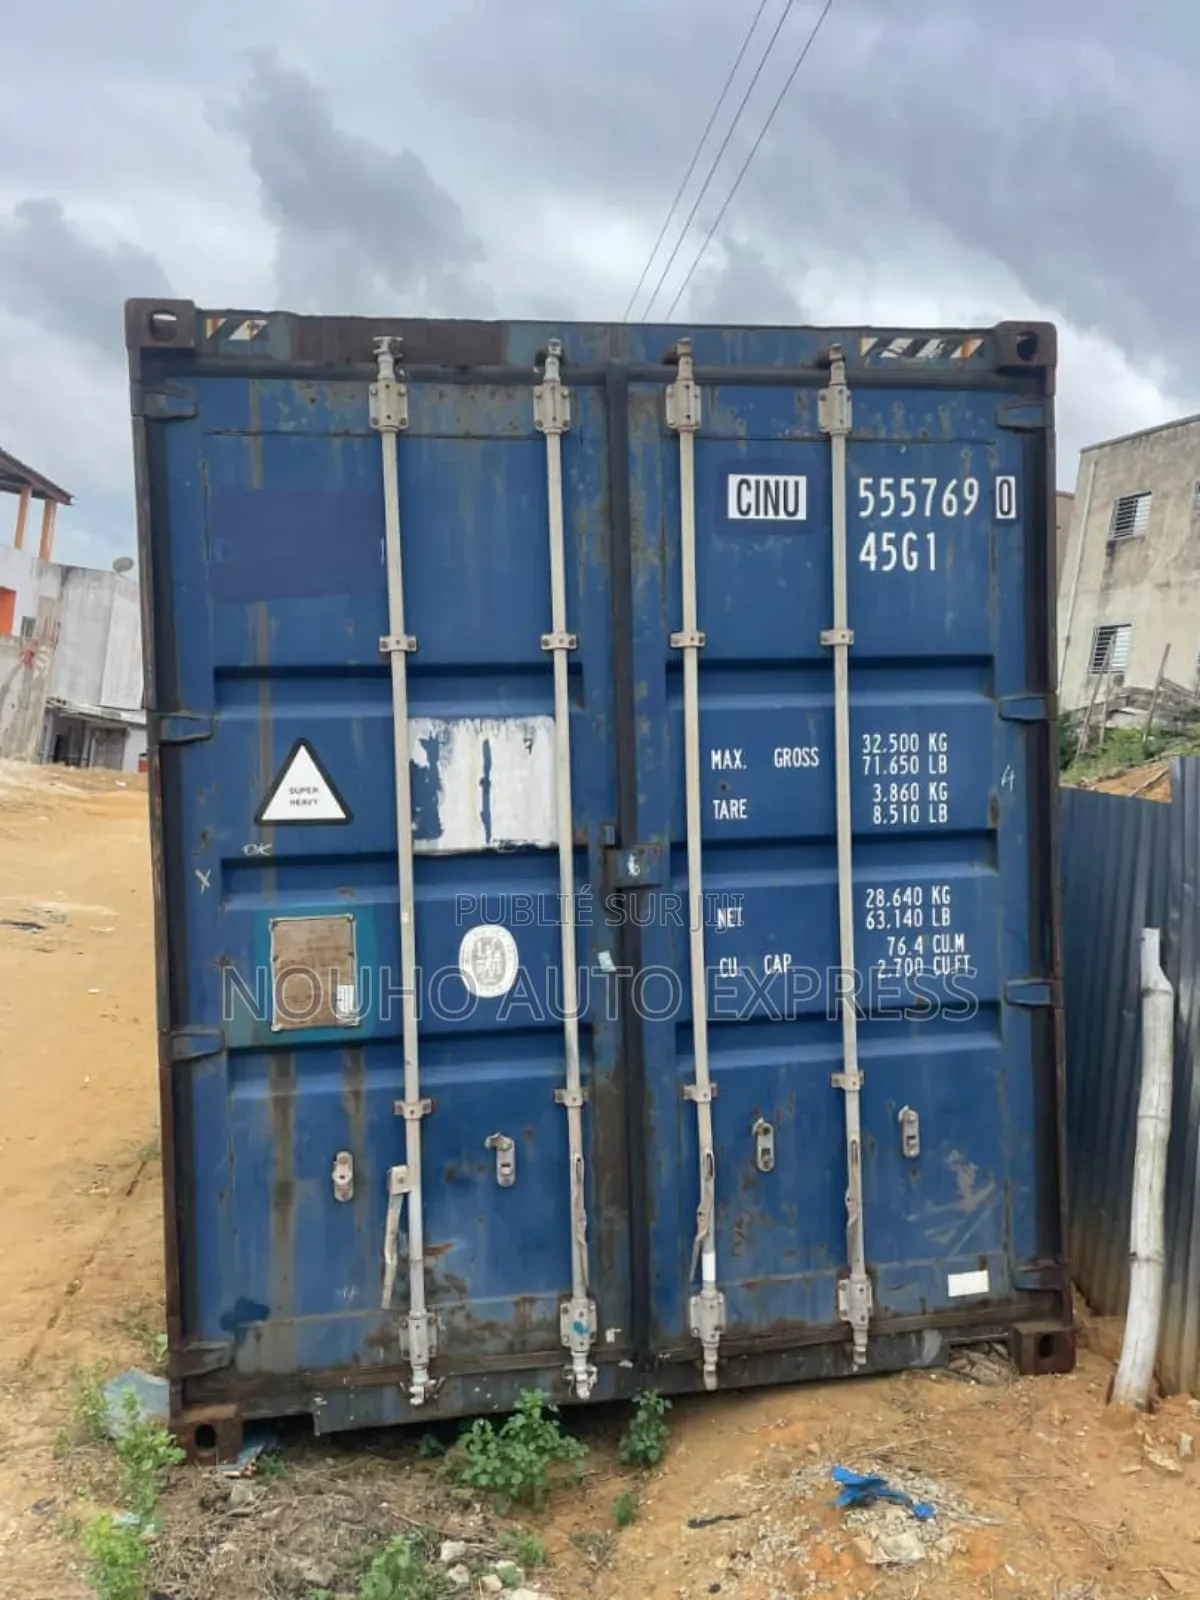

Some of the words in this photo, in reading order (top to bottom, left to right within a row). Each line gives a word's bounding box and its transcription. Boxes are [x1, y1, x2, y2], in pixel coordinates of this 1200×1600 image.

[736, 478, 800, 518] CINU
[858, 477, 980, 518] 555769
[998, 478, 1012, 517] 0
[858, 531, 937, 572] 45G1
[862, 733, 920, 754] 32.500
[928, 732, 949, 753] KG
[710, 748, 748, 770] MAX.
[773, 746, 820, 768] GROSS
[862, 755, 920, 776] 71.650
[928, 754, 948, 774] LB
[288, 786, 319, 795] SUPER
[289, 798, 319, 806] HEAVY
[872, 782, 920, 803] 3.860
[928, 781, 949, 801] KG
[712, 798, 748, 820] TARE
[872, 804, 920, 825] 8.510
[928, 803, 949, 823] LB
[865, 887, 923, 908] 28.640
[931, 885, 951, 906] KG
[716, 906, 744, 929] NET
[865, 908, 923, 930] 63.140
[931, 907, 951, 927] LB
[886, 935, 925, 957] 76.4
[932, 933, 965, 954] CU.M
[876, 957, 925, 980] 2.700
